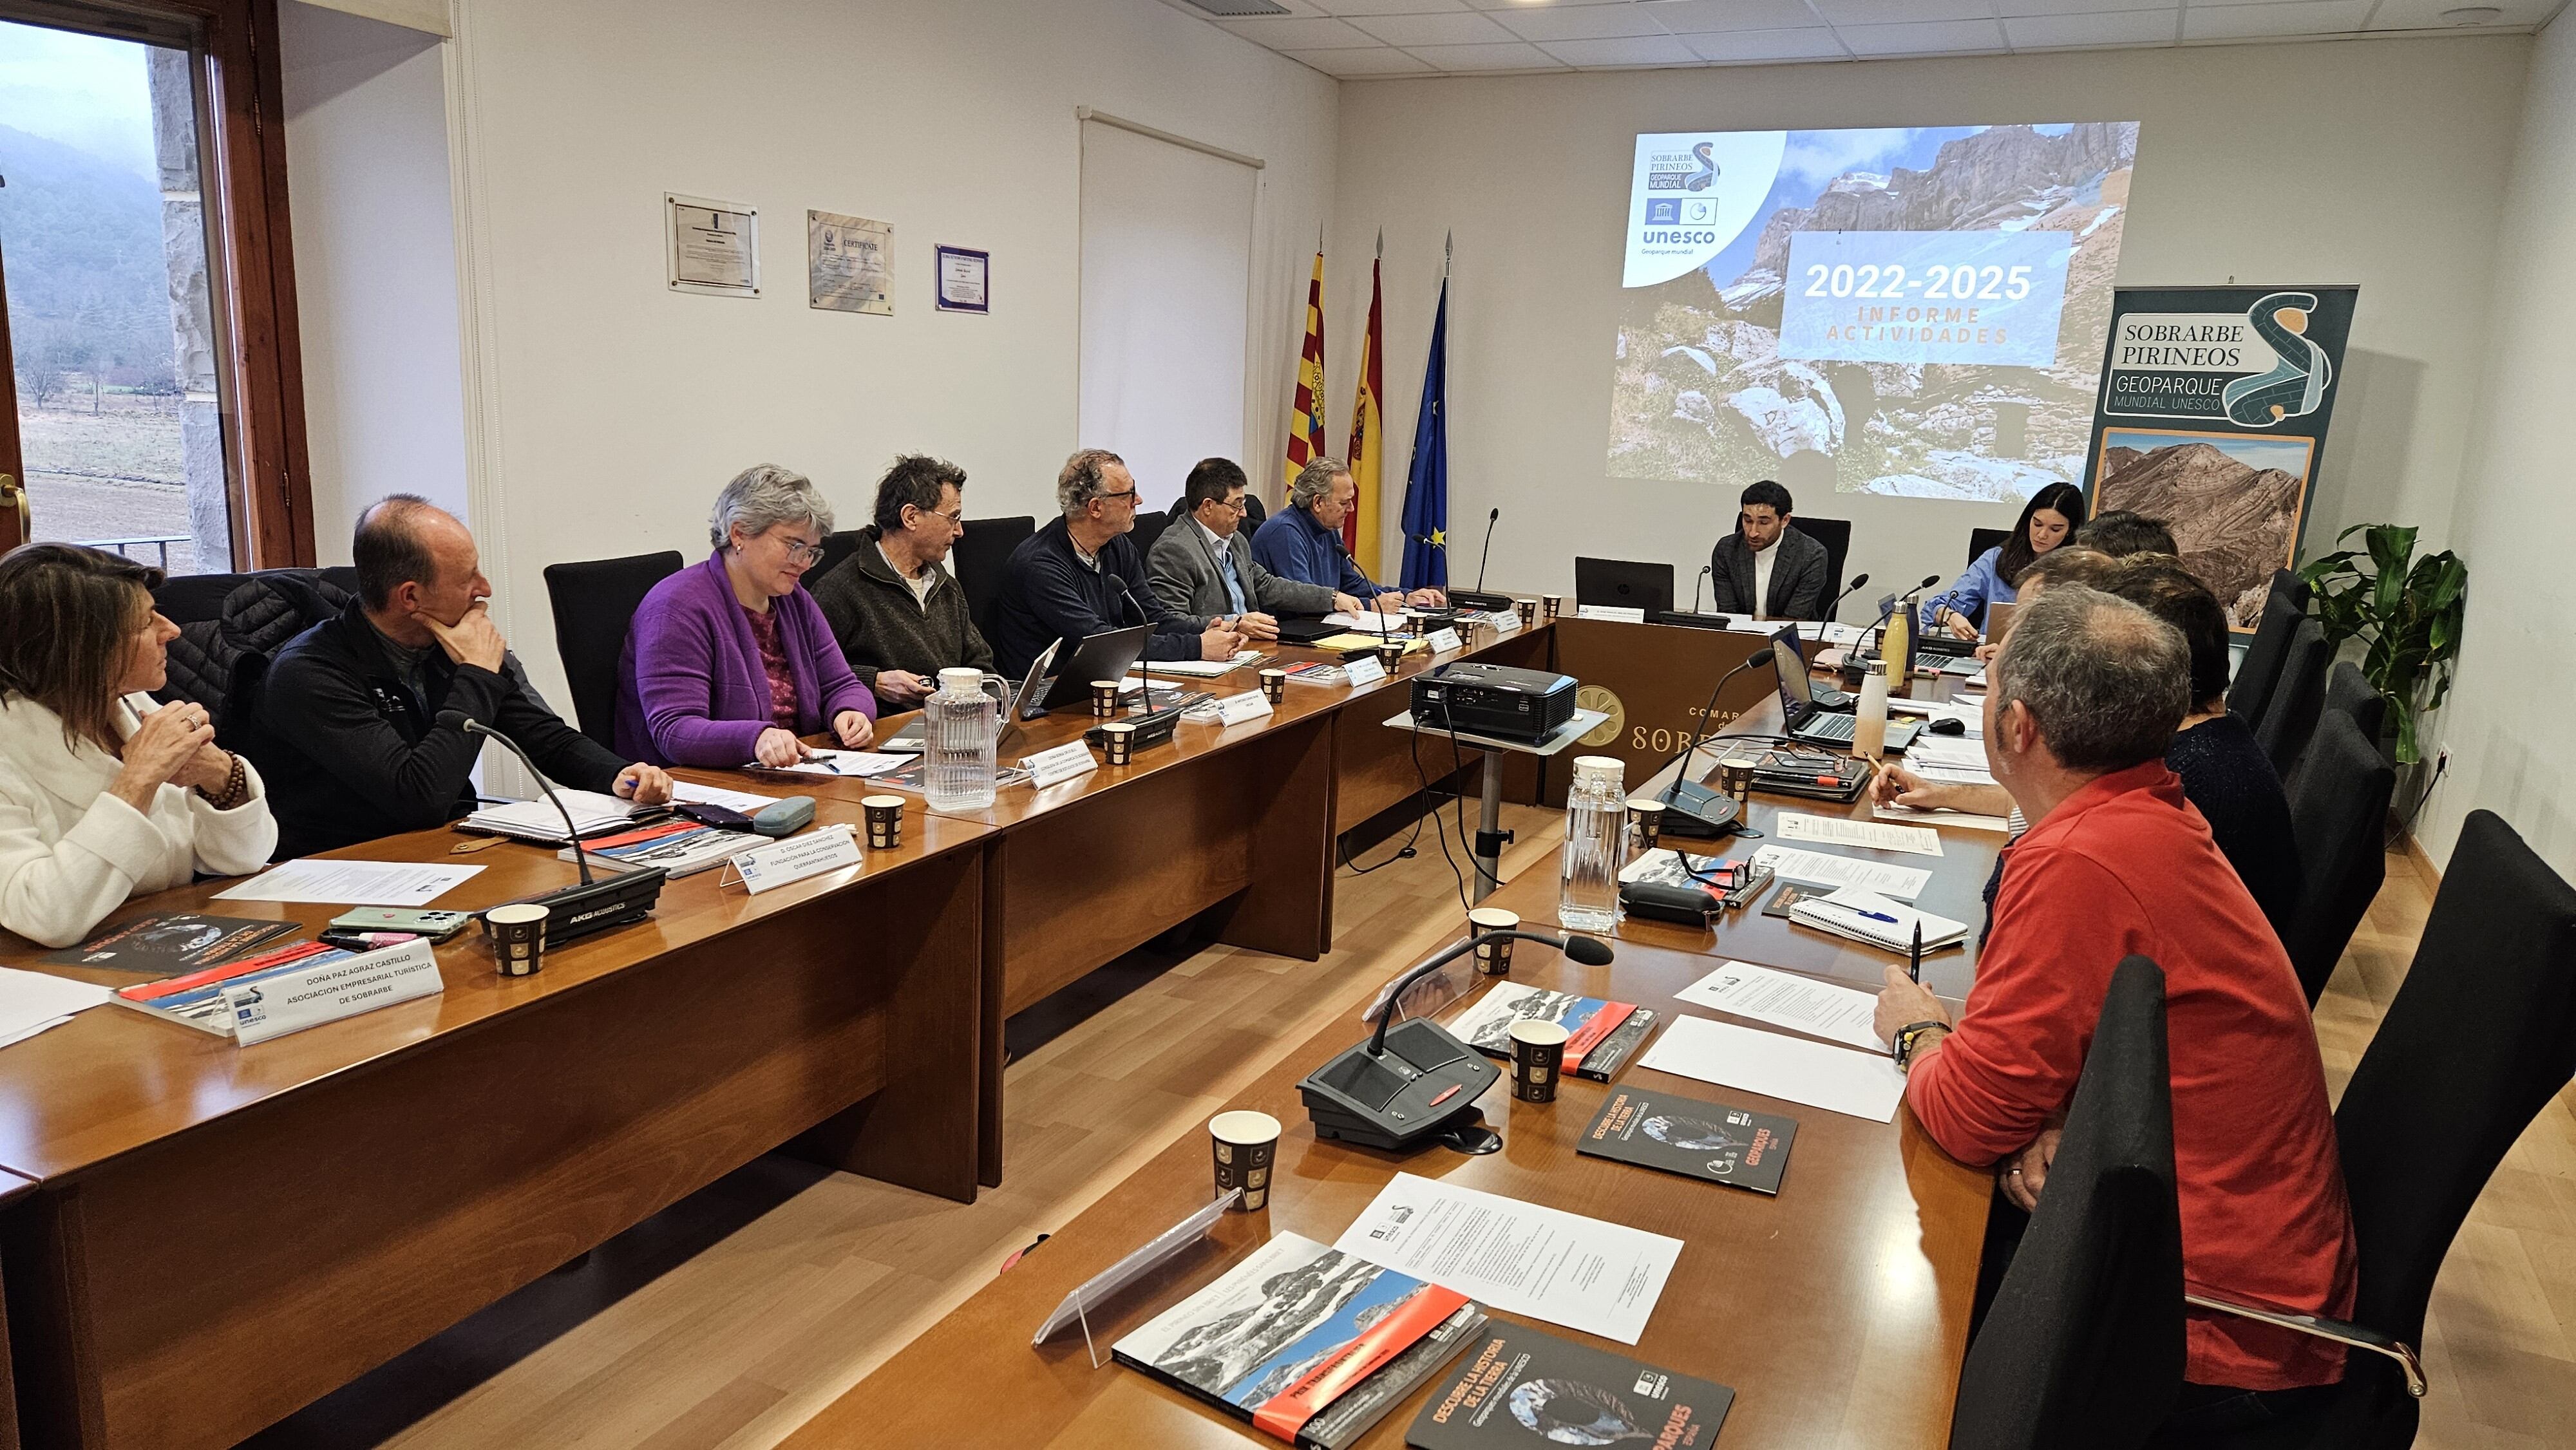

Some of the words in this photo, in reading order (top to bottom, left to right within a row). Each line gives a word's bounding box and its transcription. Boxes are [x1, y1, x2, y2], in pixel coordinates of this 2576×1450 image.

[844, 239, 878, 250] CERTIFICATE
[1643, 232, 1715, 243] unesco
[1804, 263, 2032, 300] 2022-2025
[1857, 306, 1980, 324] INFORME
[1826, 326, 2007, 344] ACTIVIDADES
[2125, 325, 2244, 343] SOBRARBE
[2121, 346, 2240, 366] PIRINEOS
[2116, 375, 2222, 396] GEOPARQUE
[2114, 396, 2166, 409] MUNDIAL
[2172, 397, 2220, 411] UNESCO
[1689, 707, 1739, 720] COMAR
[569, 912, 593, 924] AKG
[593, 902, 625, 917] ACOUSTICS
[307, 974, 331, 986] DOÑA
[332, 970, 348, 979] PAZ
[348, 963, 375, 975] AGRAZ
[375, 954, 410, 970] CASTILLO
[341, 973, 393, 991] EMPRESARIAL
[393, 962, 432, 977] TURÍSTICA
[339, 996, 350, 1005] DE
[352, 985, 393, 1001] SOBRARBE
[240, 1014, 267, 1026] unesco
[1593, 1118, 1614, 1139] DESCUBRE
[1609, 1095, 1628, 1114] HISTORIA
[1745, 1128, 1770, 1165] GEOPARQUES
[1432, 1381, 1473, 1424] DESCUBRE
[1463, 1372, 1481, 1384] LA
[1472, 1339, 1506, 1374] HISTORIA
[1479, 1361, 1508, 1386] TIERRA
[1472, 1385, 1489, 1397] LA
[1463, 1395, 1481, 1408] DE
[1653, 1404, 1692, 1450] PARQUES
